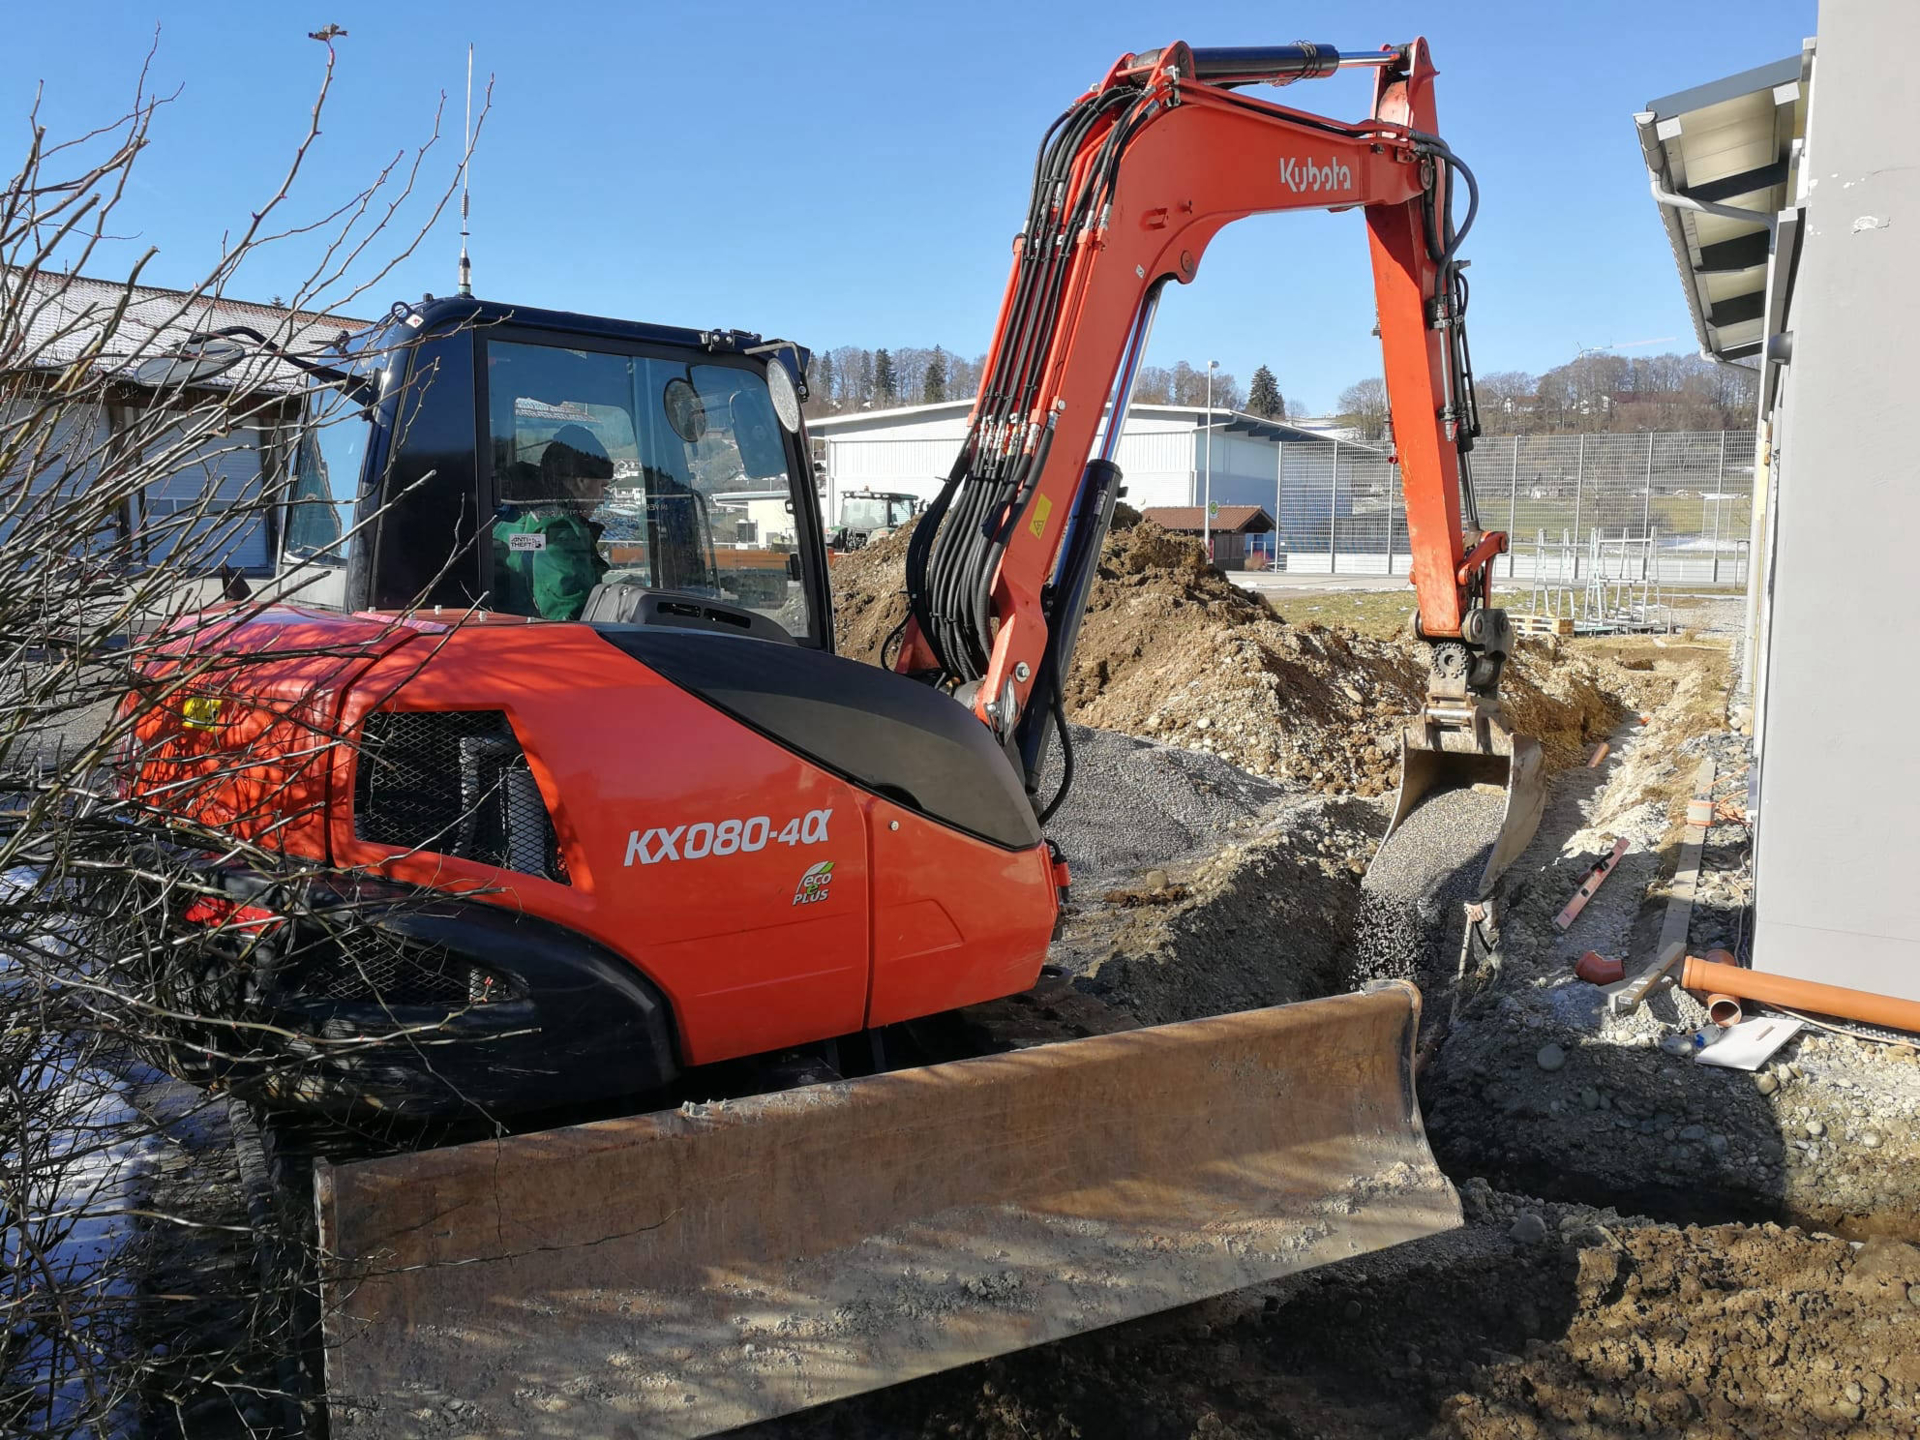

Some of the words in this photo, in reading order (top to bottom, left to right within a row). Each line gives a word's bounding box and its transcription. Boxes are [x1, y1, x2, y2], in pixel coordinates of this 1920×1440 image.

[1279, 156, 1351, 193] Kubota
[803, 873, 832, 888] eco
[792, 889, 829, 906] PLUS
